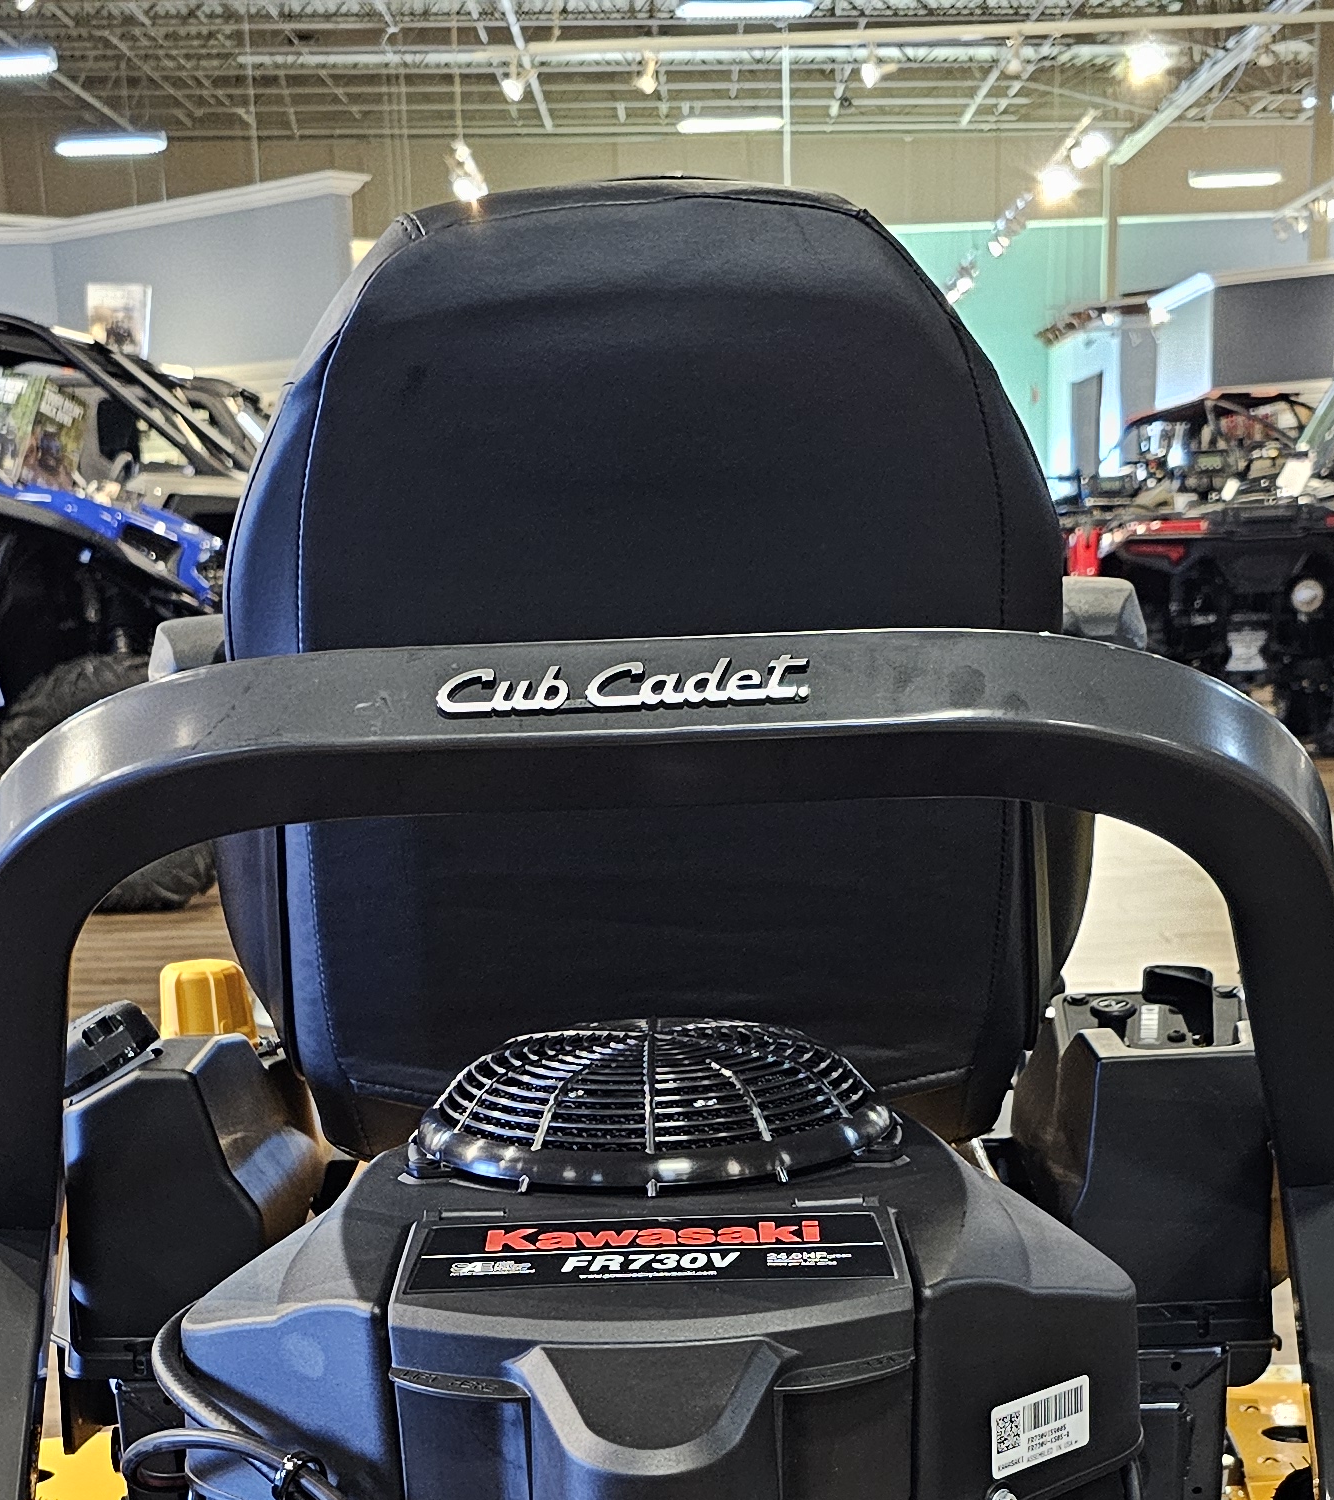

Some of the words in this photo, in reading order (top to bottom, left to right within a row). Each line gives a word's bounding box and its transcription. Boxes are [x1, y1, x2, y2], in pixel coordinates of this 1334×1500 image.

[436, 665, 569, 716] Cub
[484, 1220, 821, 1252] Kawasaki
[560, 1251, 741, 1273] FR730V
[1027, 1447, 1054, 1463] ASSEMBLED
